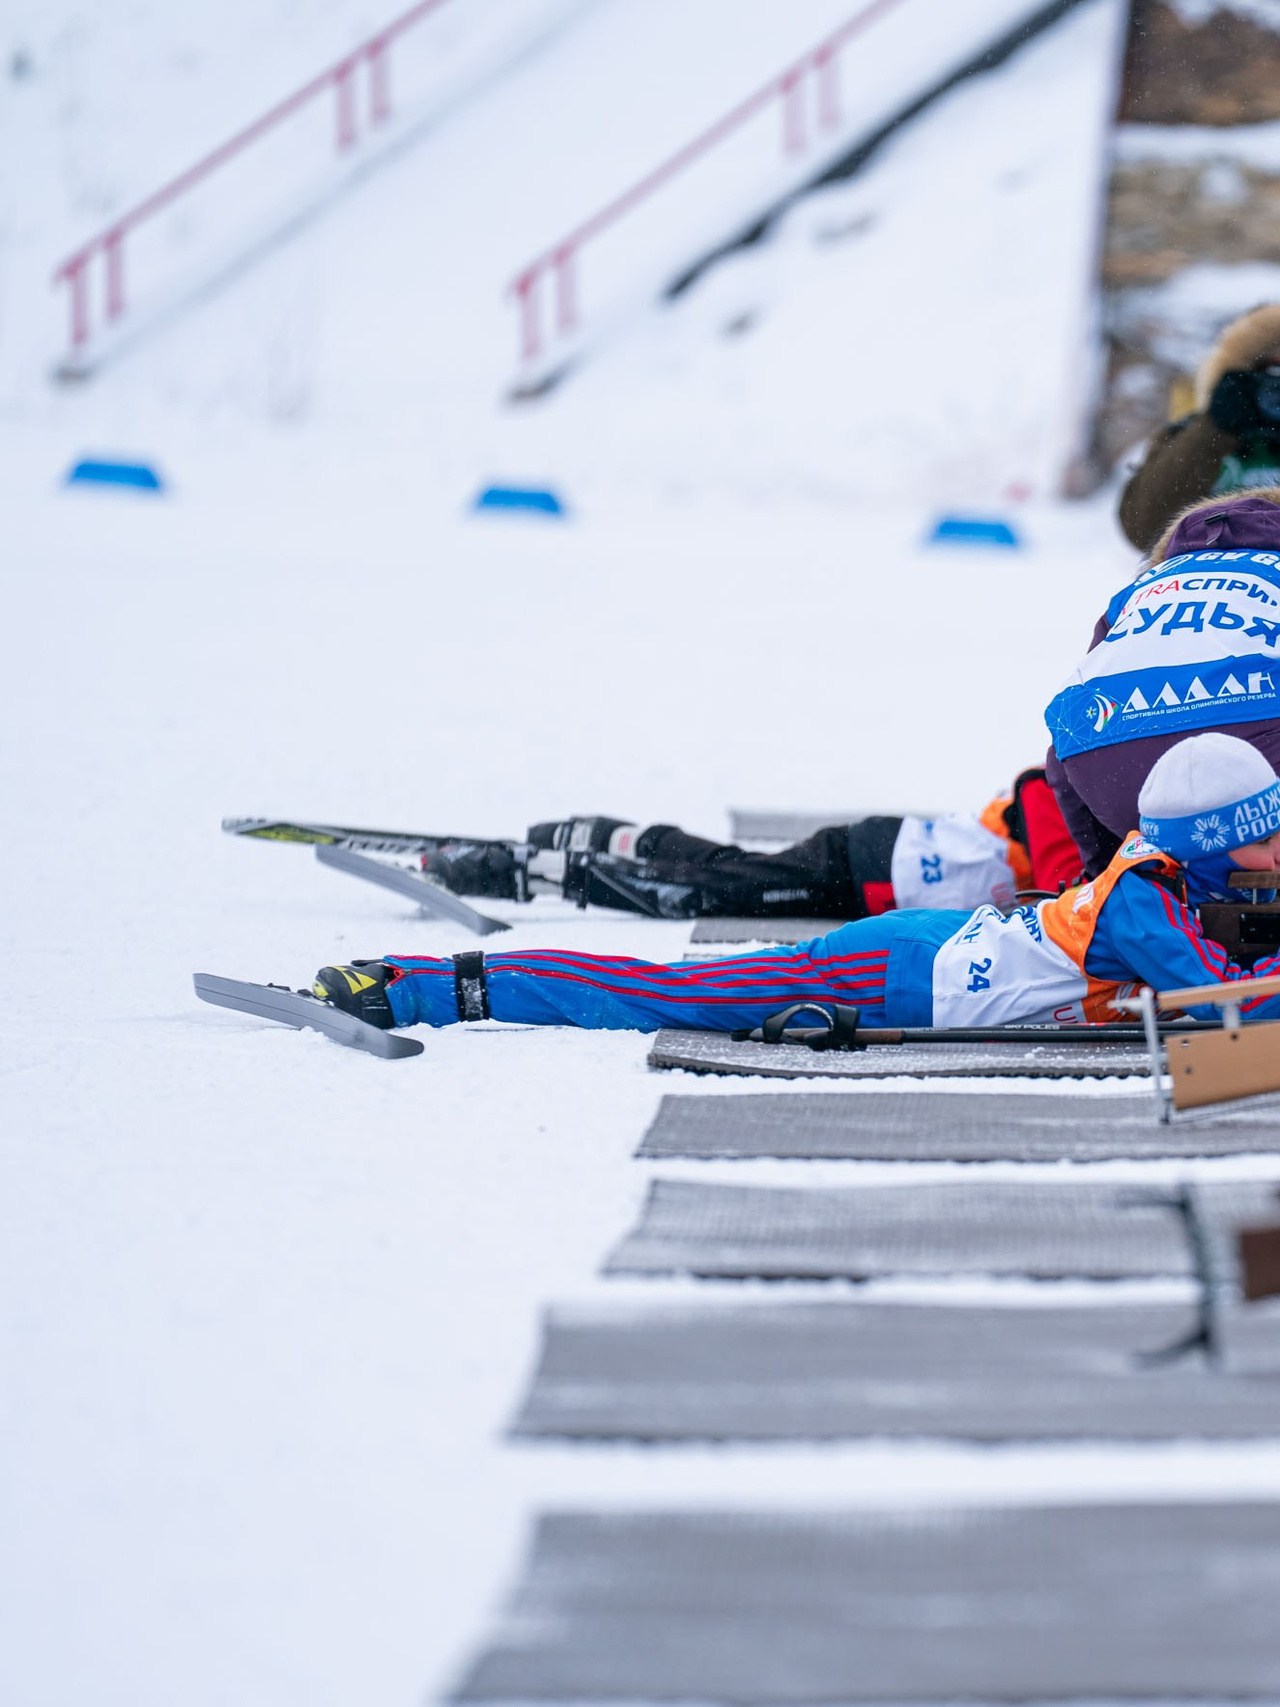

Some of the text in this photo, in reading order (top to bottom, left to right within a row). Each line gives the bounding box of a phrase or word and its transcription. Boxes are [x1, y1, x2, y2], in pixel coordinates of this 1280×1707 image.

[1195, 552, 1250, 562] GV
[1121, 672, 1276, 714] АЛДАН
[1121, 691, 1277, 722] СПОРТИВНАЯ ШКОЛА ОЛИМПИЙСКОГО РЕЗЕРВА
[920, 854, 943, 884] 23
[966, 957, 992, 993] 24
